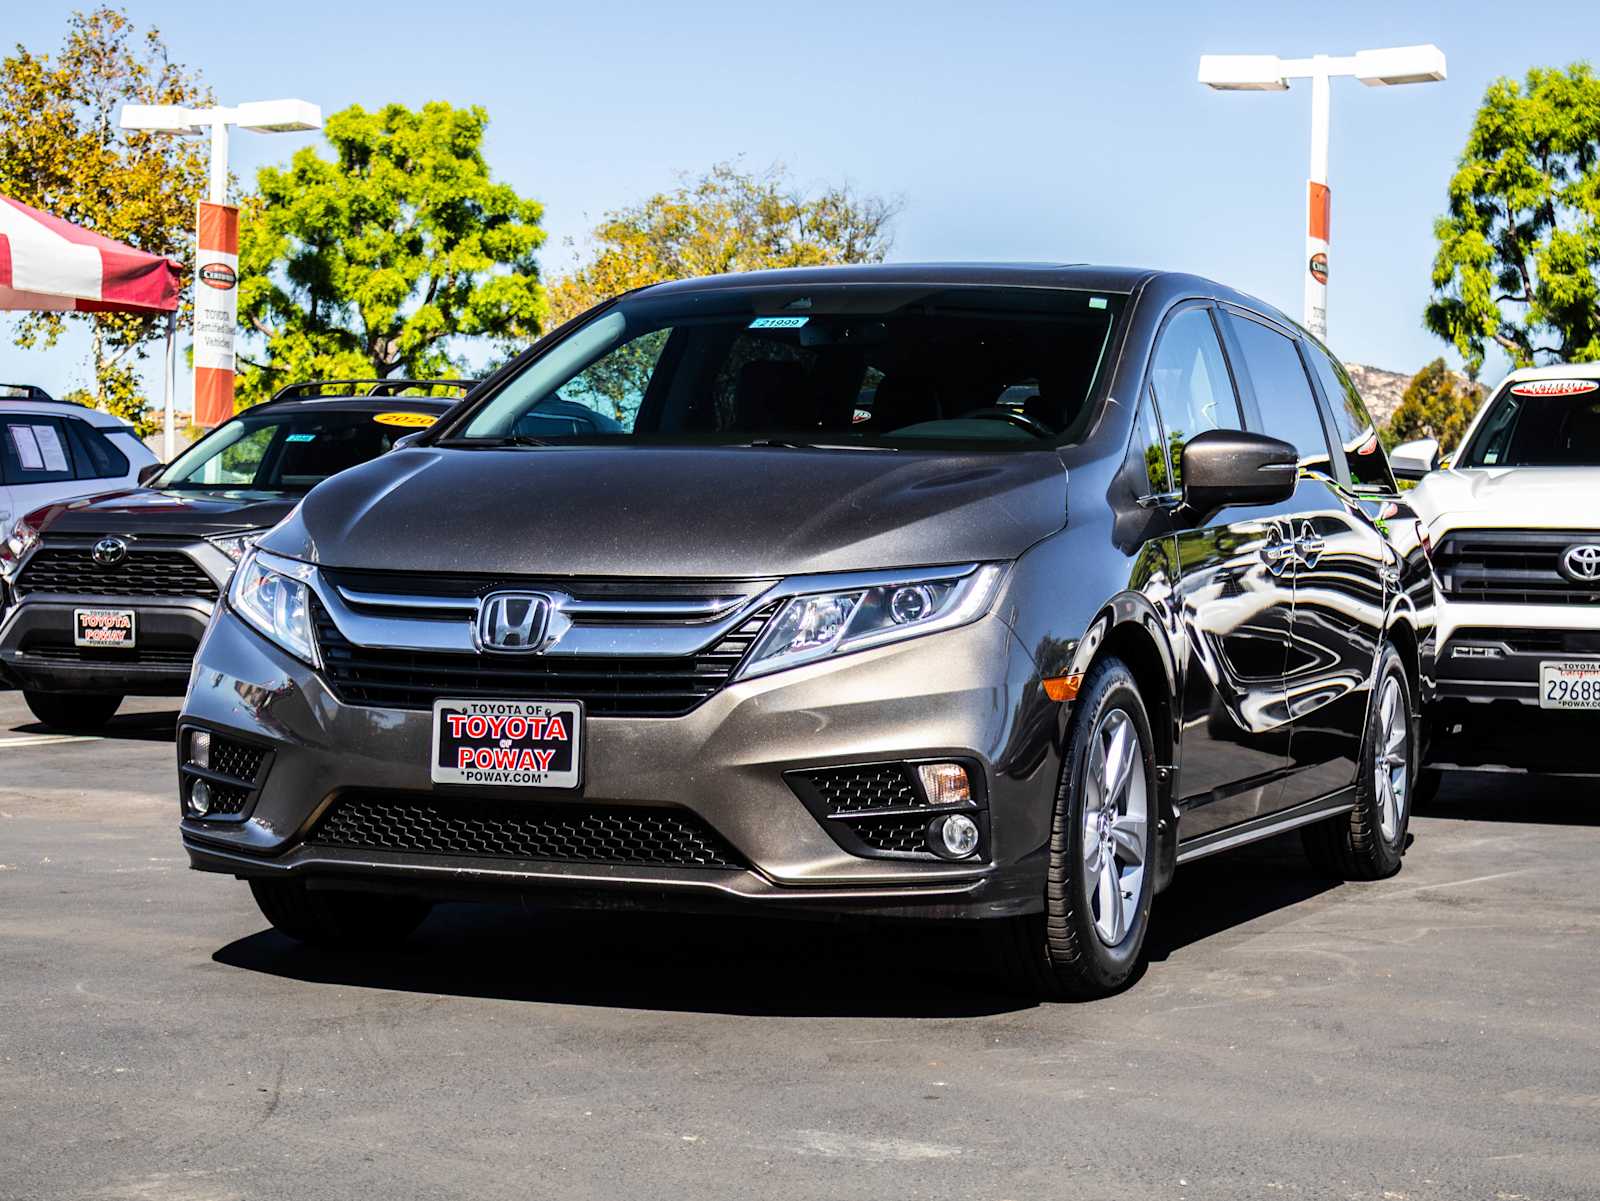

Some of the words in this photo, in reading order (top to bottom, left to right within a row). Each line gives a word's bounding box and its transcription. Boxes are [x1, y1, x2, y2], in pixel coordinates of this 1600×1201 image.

[382, 415, 434, 425] 2020
[80, 615, 131, 628] TOYOTA
[85, 629, 127, 641] POWAY
[1547, 680, 1600, 701] 29688
[471, 704, 522, 715] TOYOTA
[526, 705, 542, 715] OF
[447, 714, 568, 741] TOYOTA
[458, 747, 556, 772] POWAY
[466, 771, 542, 783] POWAY.COM
